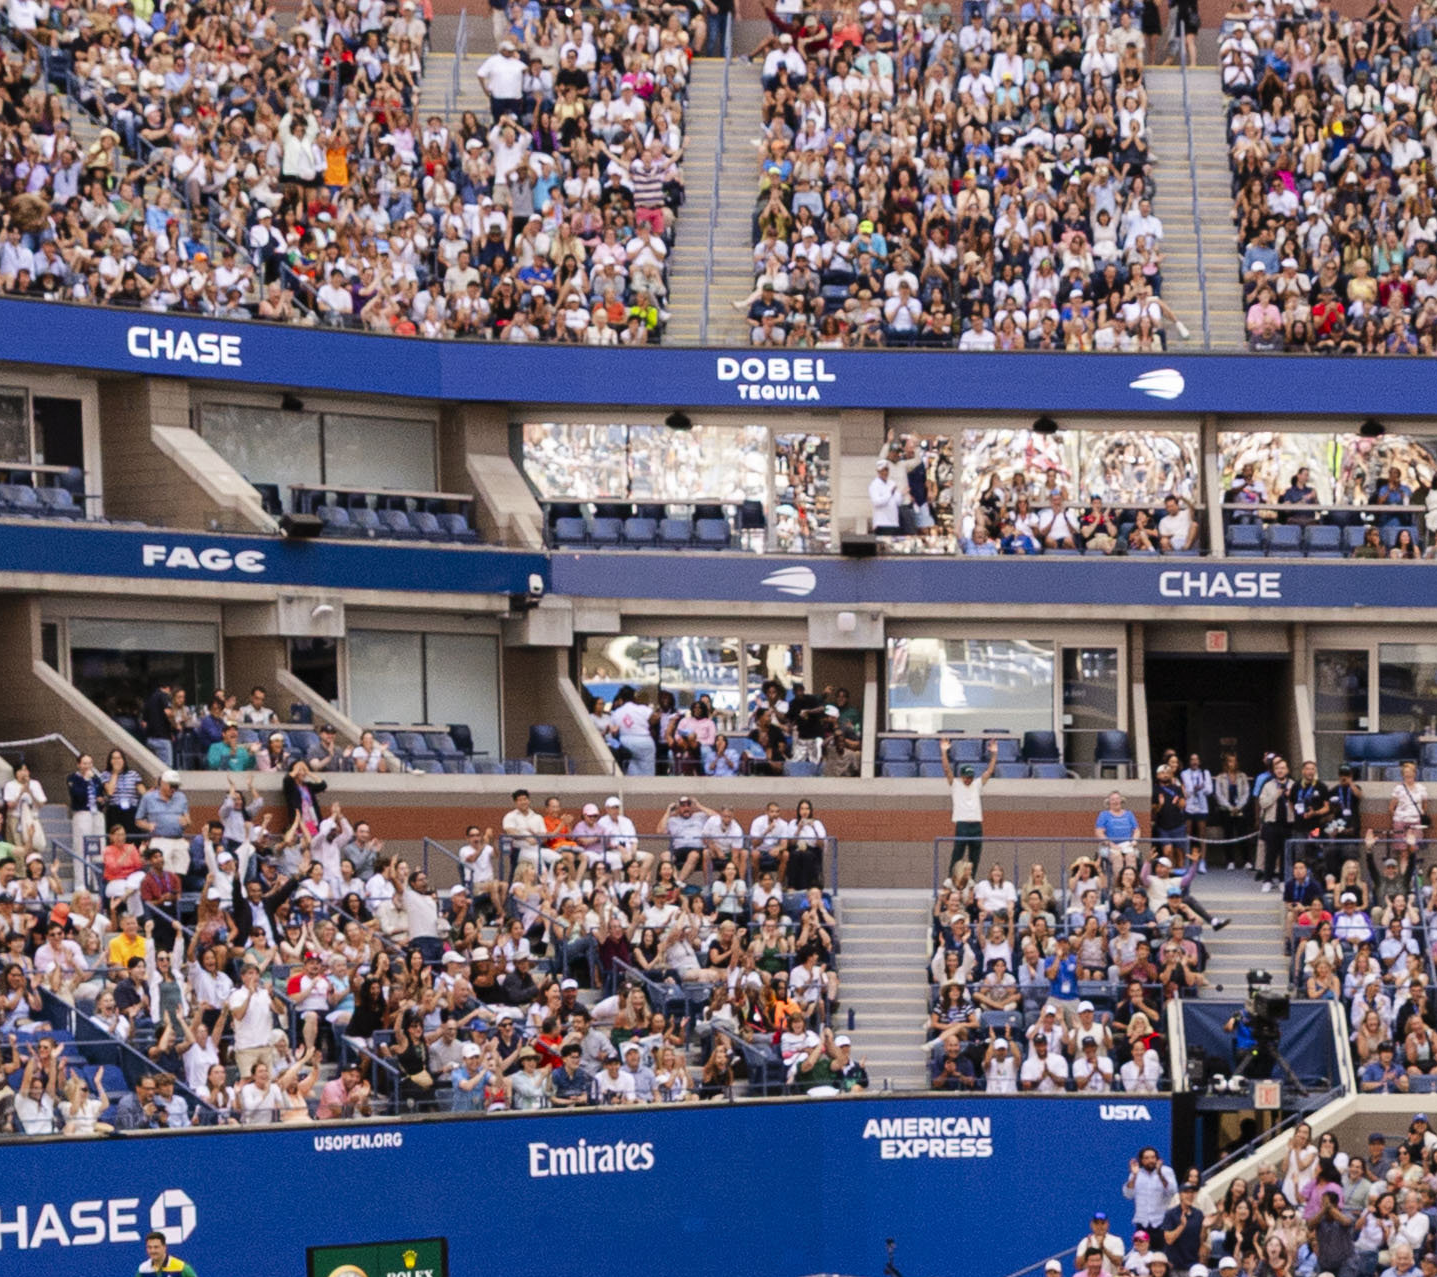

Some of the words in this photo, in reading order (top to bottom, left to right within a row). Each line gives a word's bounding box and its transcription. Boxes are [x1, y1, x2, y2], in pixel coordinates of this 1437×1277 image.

[127, 326, 242, 367] CHASE
[717, 357, 836, 383] DOBEL
[737, 383, 821, 401] TEQUILA
[1159, 571, 1282, 598] CHASE
[1099, 1104, 1151, 1121] USTA
[862, 1116, 992, 1140] AMERICAN
[314, 1131, 403, 1152] USOPEN.ORG
[879, 1137, 993, 1159] EXPRESS
[528, 1138, 655, 1178] Emirates
